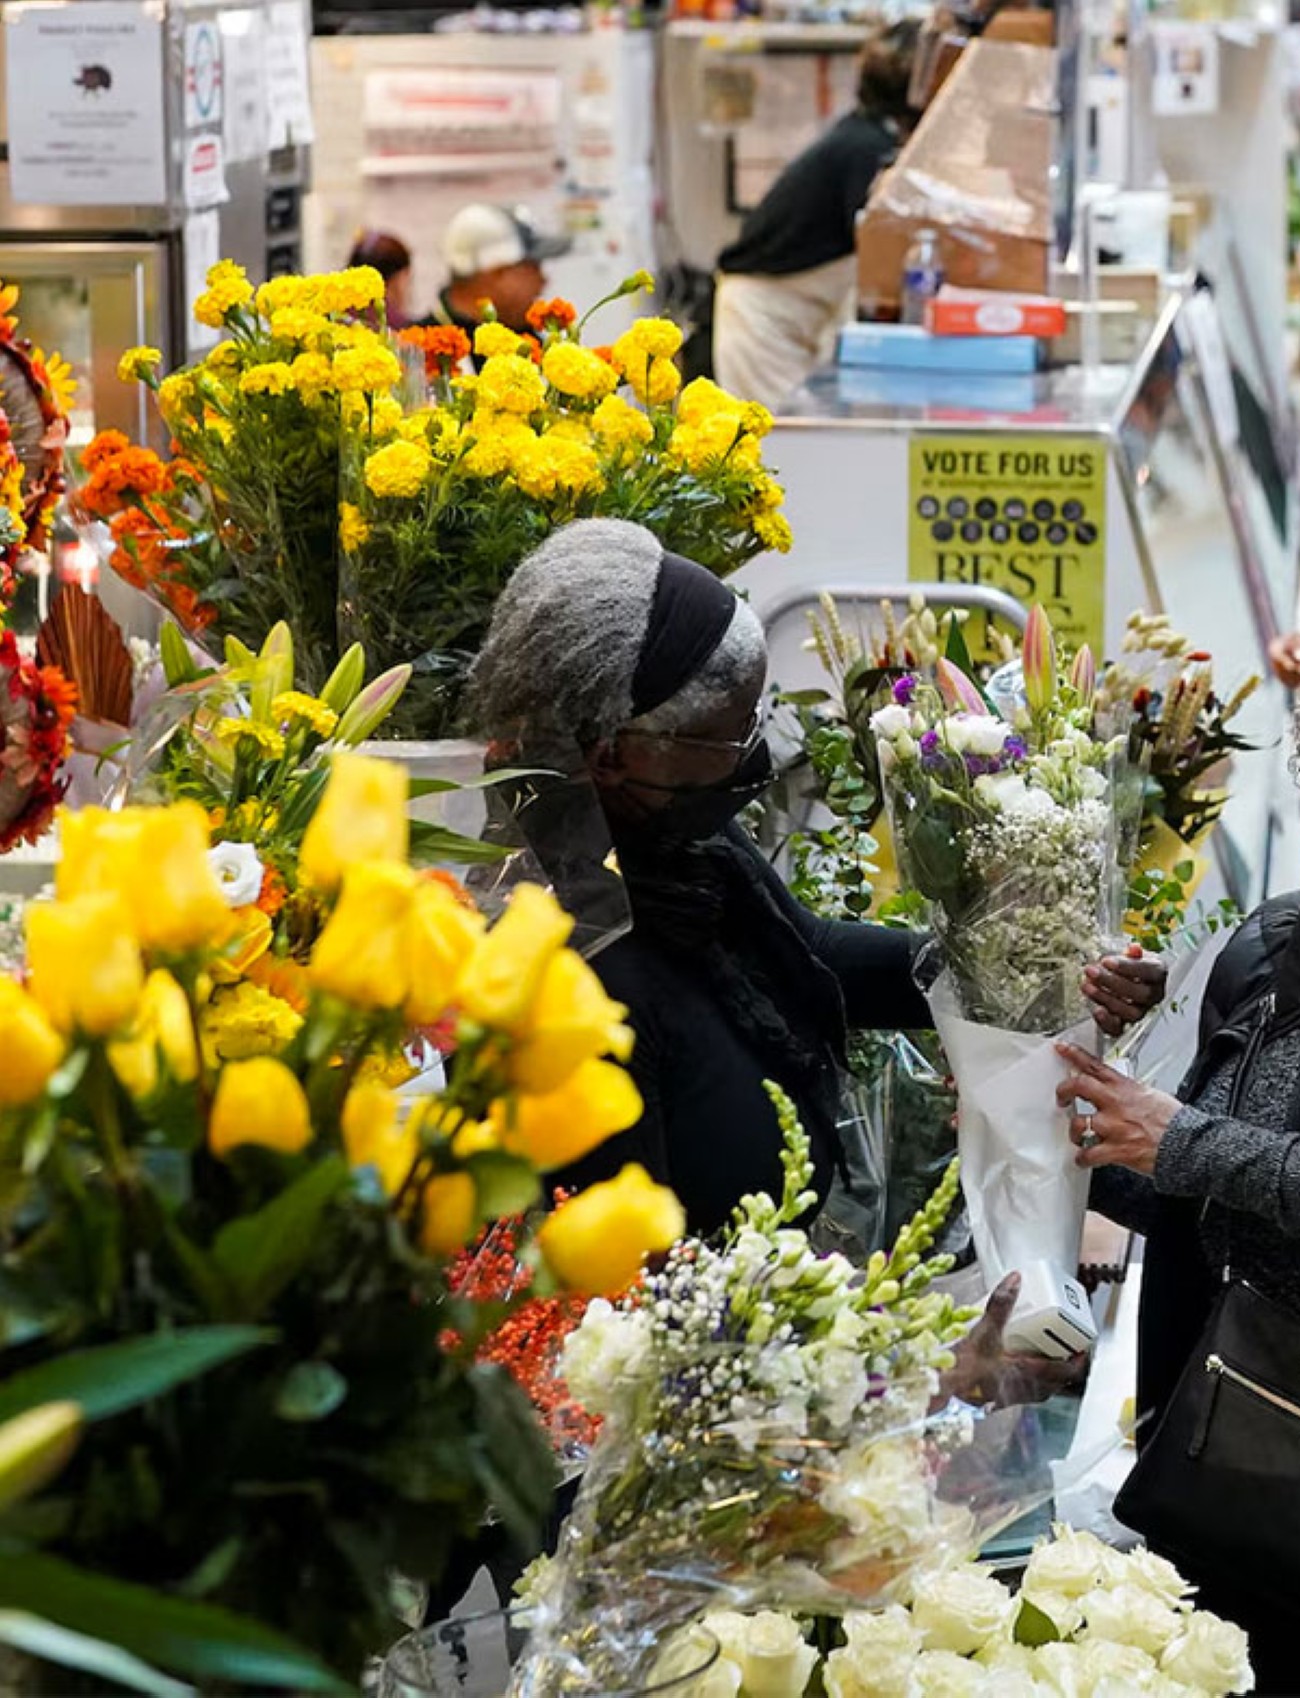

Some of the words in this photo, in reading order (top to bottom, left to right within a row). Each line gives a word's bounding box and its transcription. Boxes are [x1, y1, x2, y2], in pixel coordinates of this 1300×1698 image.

[922, 450, 991, 475] VOTE
[998, 451, 1050, 476] FOR
[1058, 452, 1094, 477] US
[935, 552, 1080, 599] BEST
